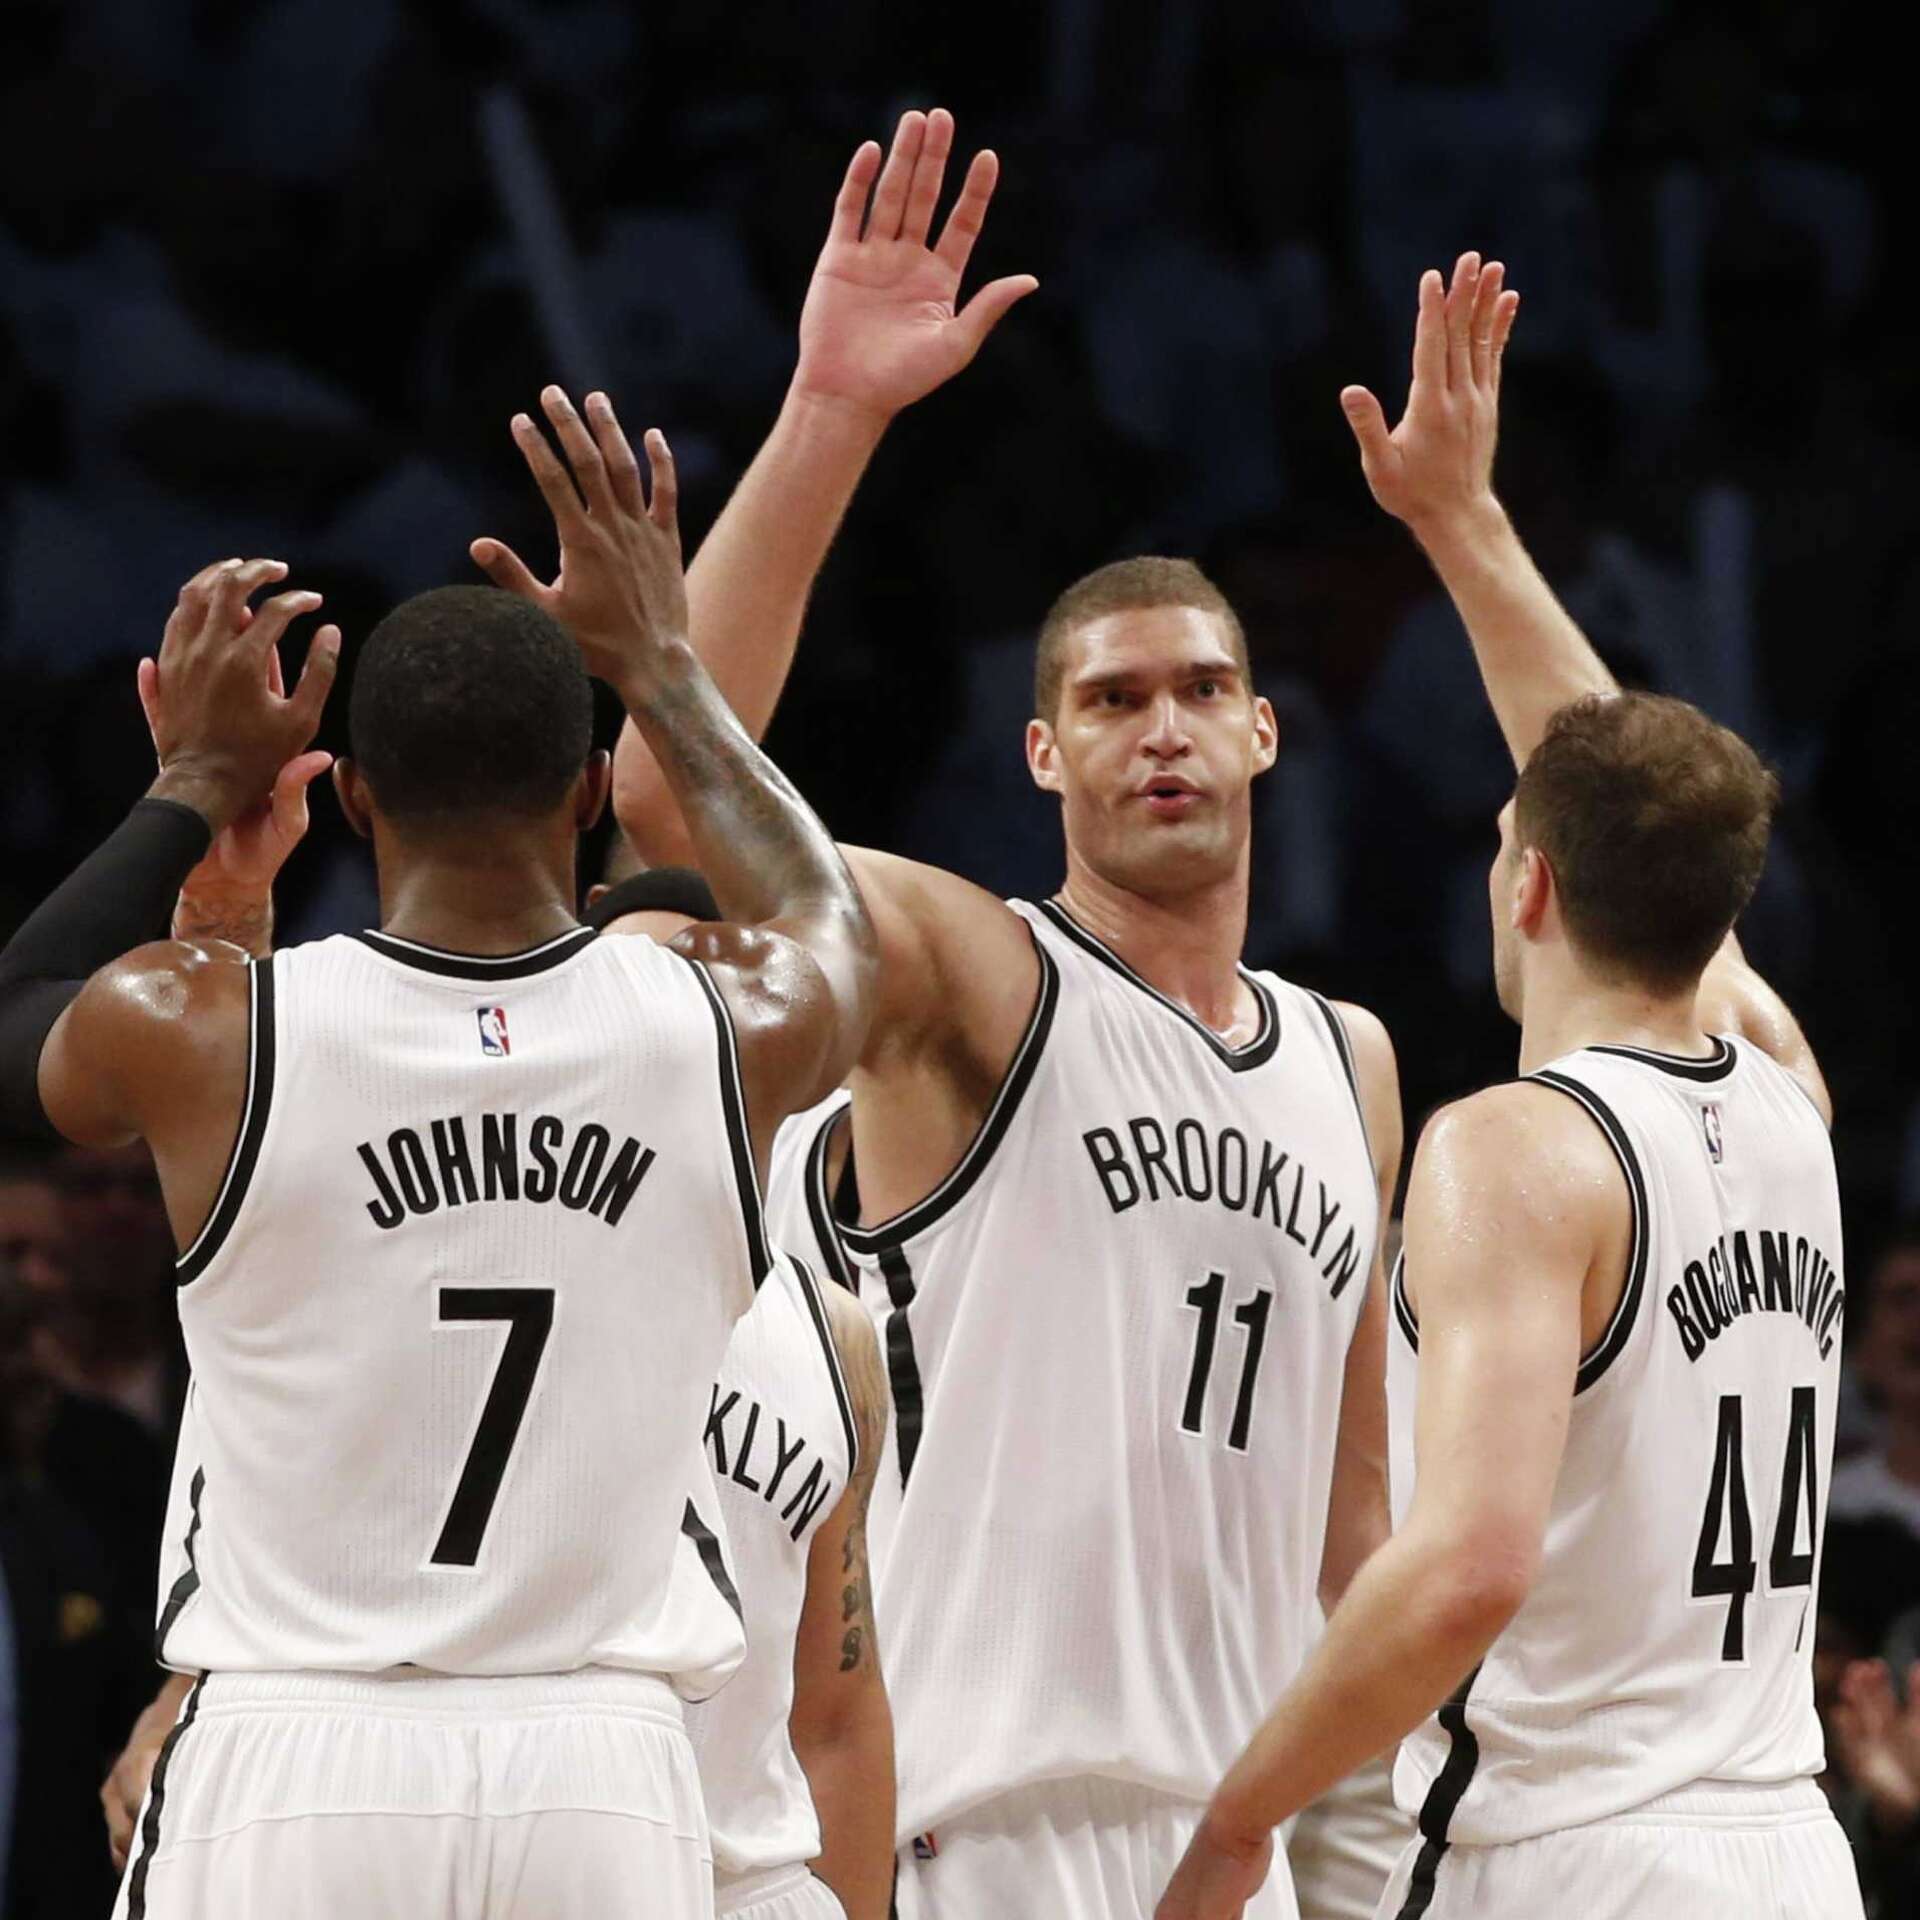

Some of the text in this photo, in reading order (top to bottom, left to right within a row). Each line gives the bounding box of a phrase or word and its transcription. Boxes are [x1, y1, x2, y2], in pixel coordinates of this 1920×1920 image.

[357, 1113, 657, 1229] JOHNSON
[1082, 1117, 1360, 1300] BROOKLYN
[429, 1287, 556, 1566] 7
[1181, 1271, 1273, 1451] 11
[703, 1382, 832, 1543] KLYN
[1691, 1386, 1817, 1661] 44
